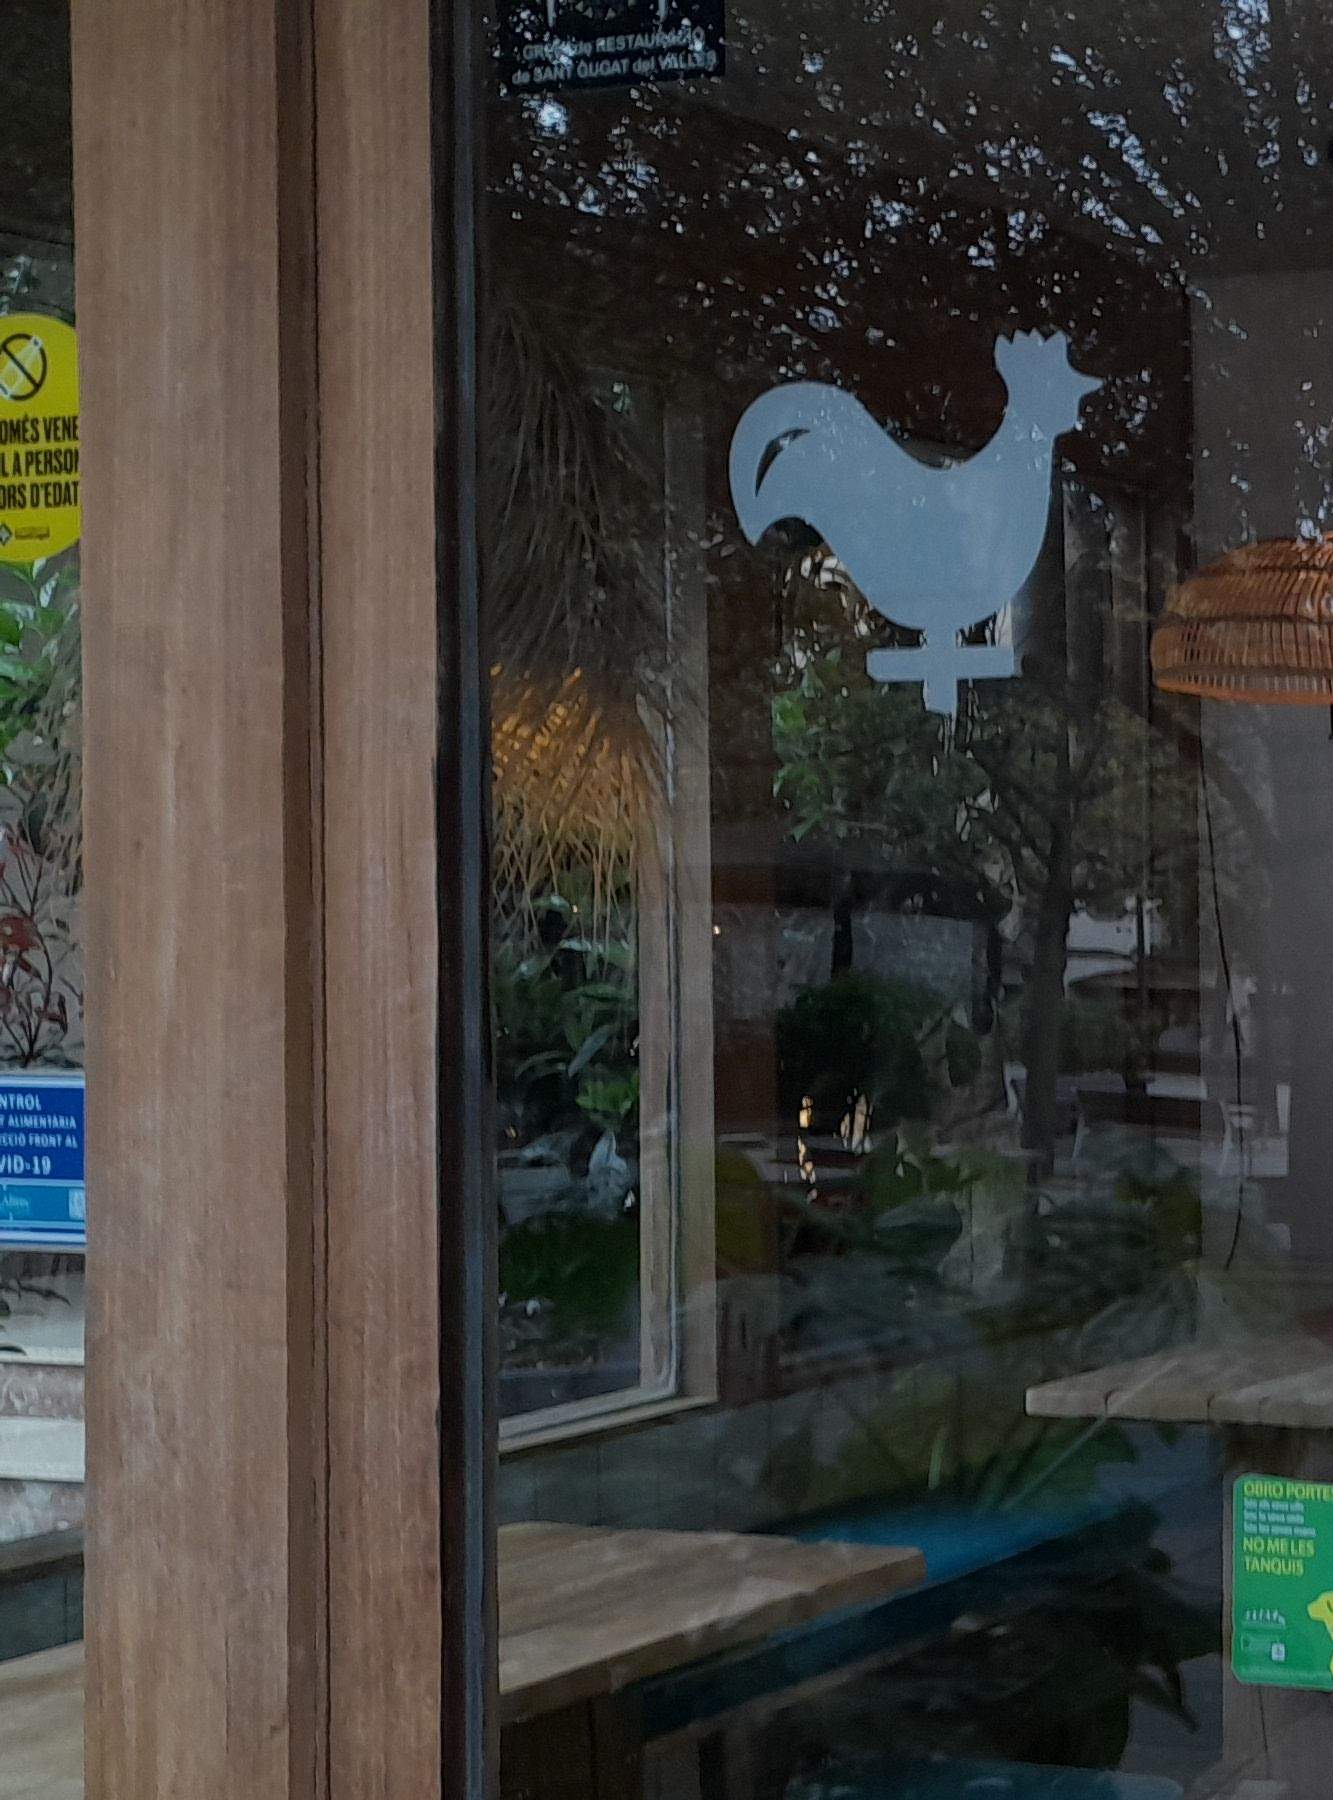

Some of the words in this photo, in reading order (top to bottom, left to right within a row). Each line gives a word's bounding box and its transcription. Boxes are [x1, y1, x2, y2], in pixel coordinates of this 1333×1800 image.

[13, 451, 22, 477] A
[1243, 1536, 1264, 1554] NO
[1266, 1538, 1287, 1555] ME
